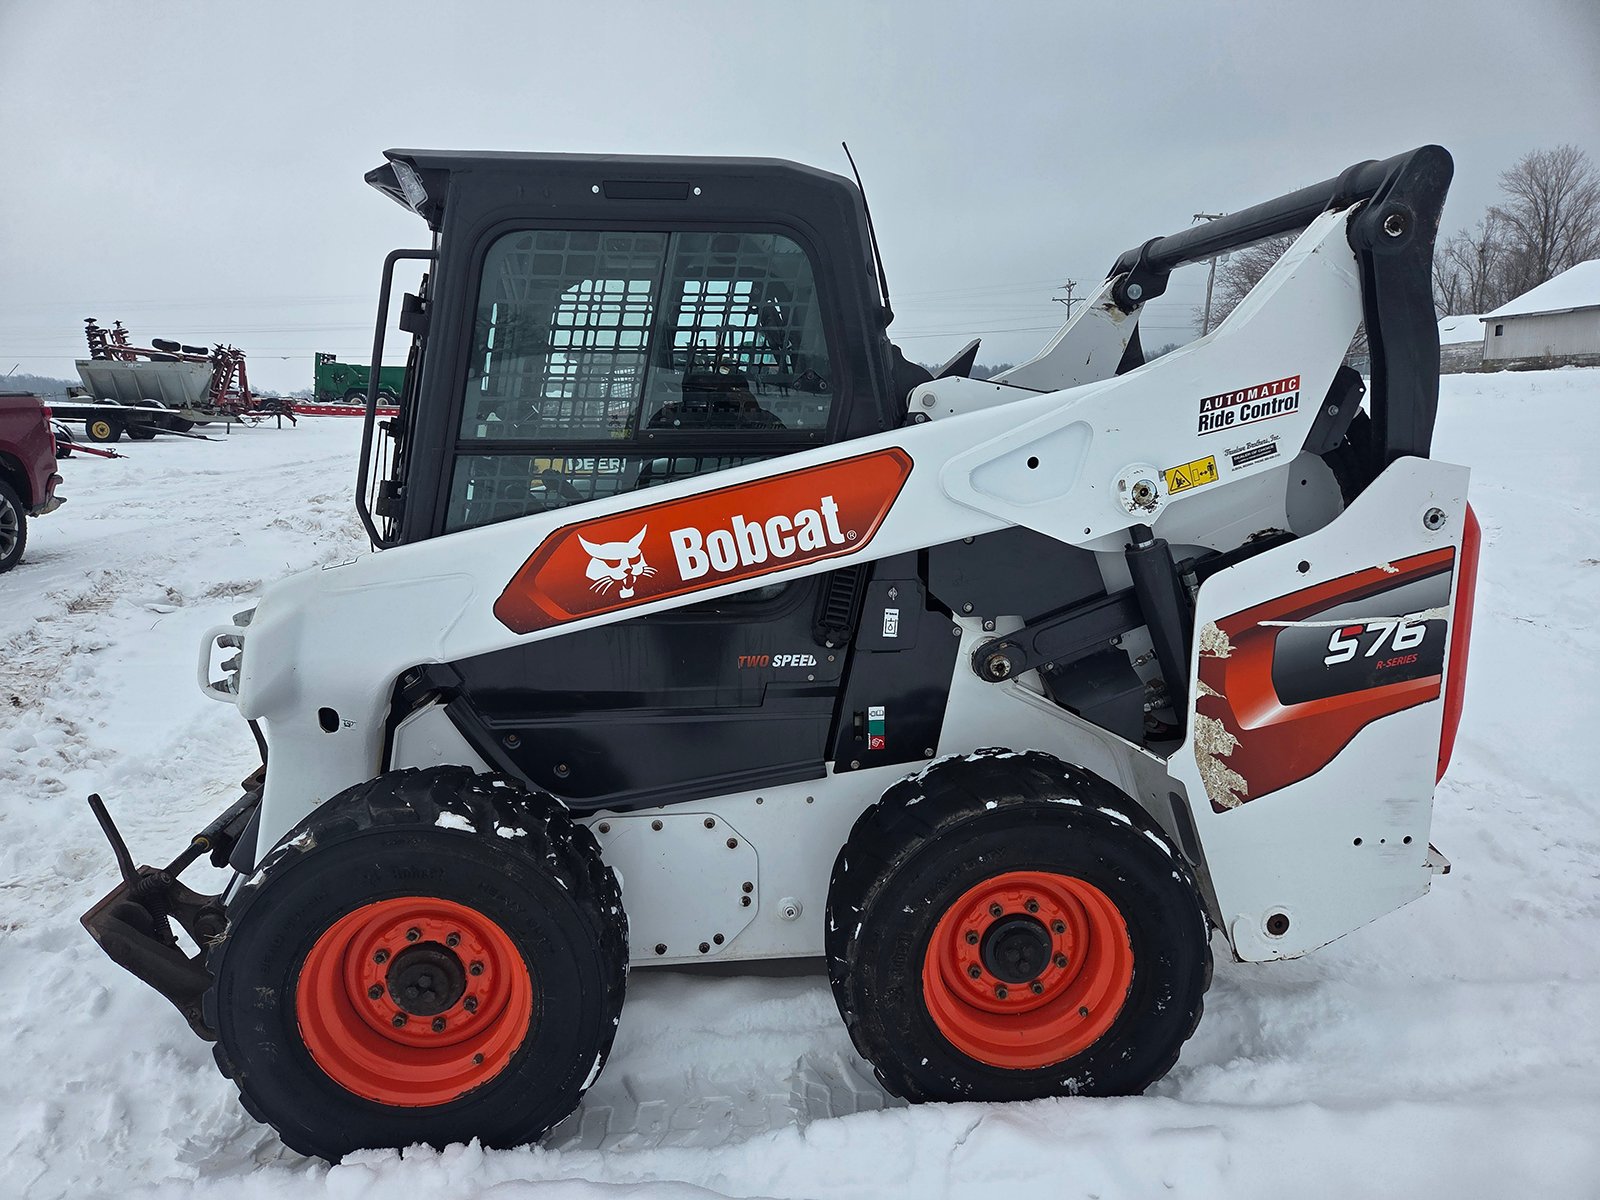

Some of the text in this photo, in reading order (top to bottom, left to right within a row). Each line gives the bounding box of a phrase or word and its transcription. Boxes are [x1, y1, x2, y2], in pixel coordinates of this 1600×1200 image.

[1198, 392, 1299, 433] Ride Control
[1203, 378, 1297, 411] AUTOMATIC
[671, 496, 845, 581] Bobcat
[1324, 612, 1427, 665] S76
[738, 654, 817, 668] TWO SPEED
[1375, 653, 1419, 670] R-SERIES
